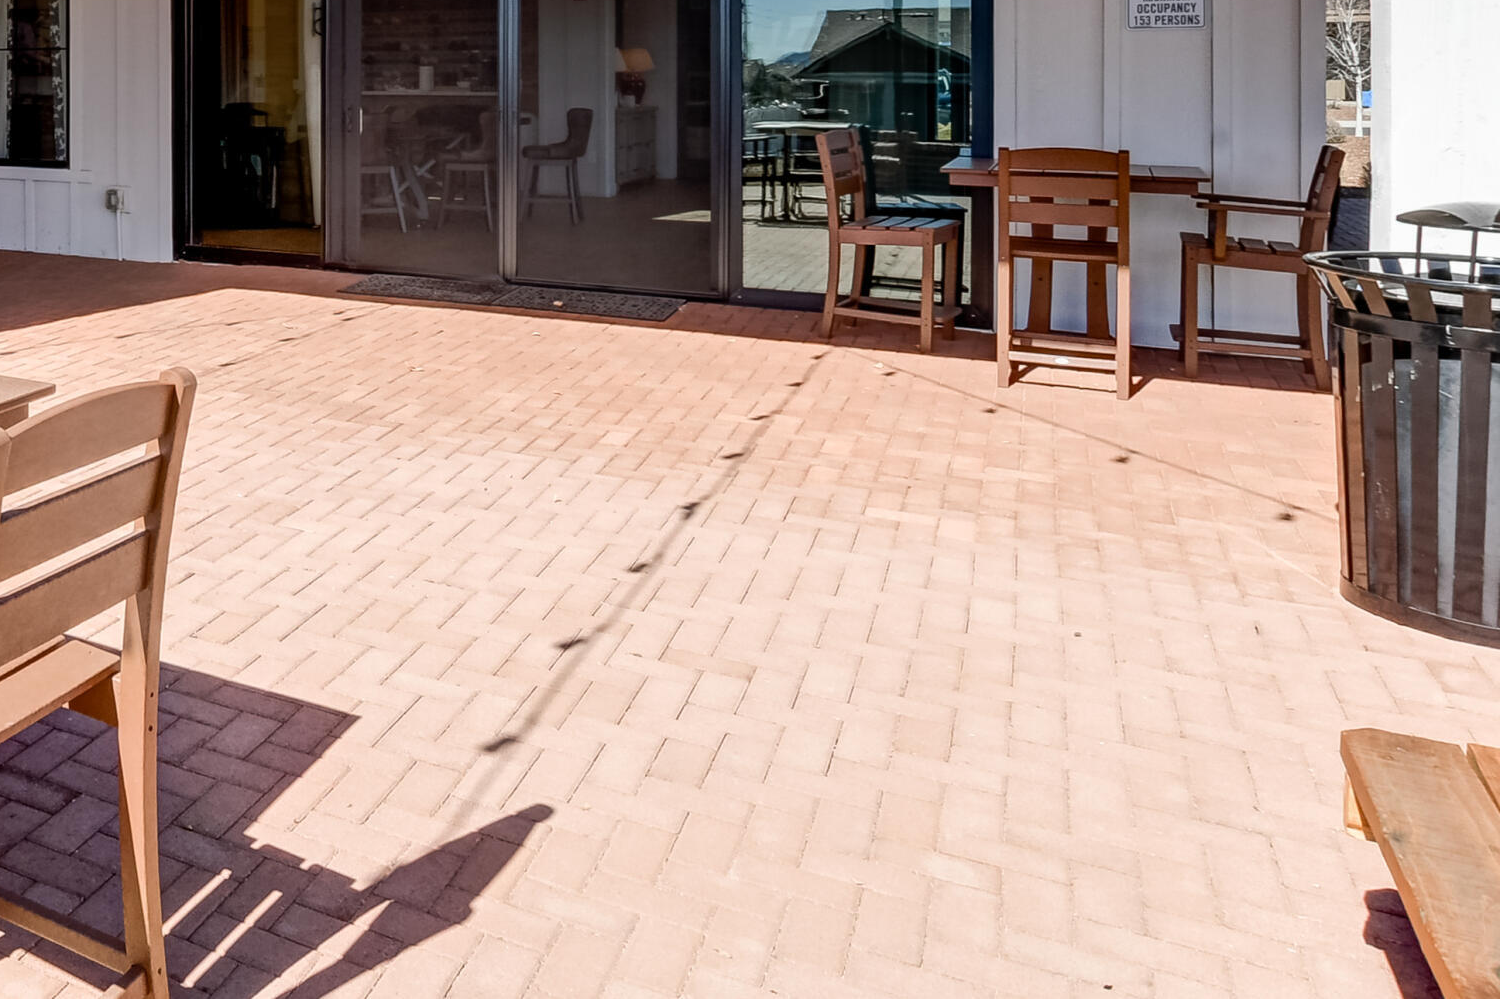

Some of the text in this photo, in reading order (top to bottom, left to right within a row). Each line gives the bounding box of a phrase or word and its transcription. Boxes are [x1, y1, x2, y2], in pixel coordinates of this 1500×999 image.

[1136, 2, 1197, 14] OCCUPANCY
[1134, 14, 1200, 26] 153 PERSONS
